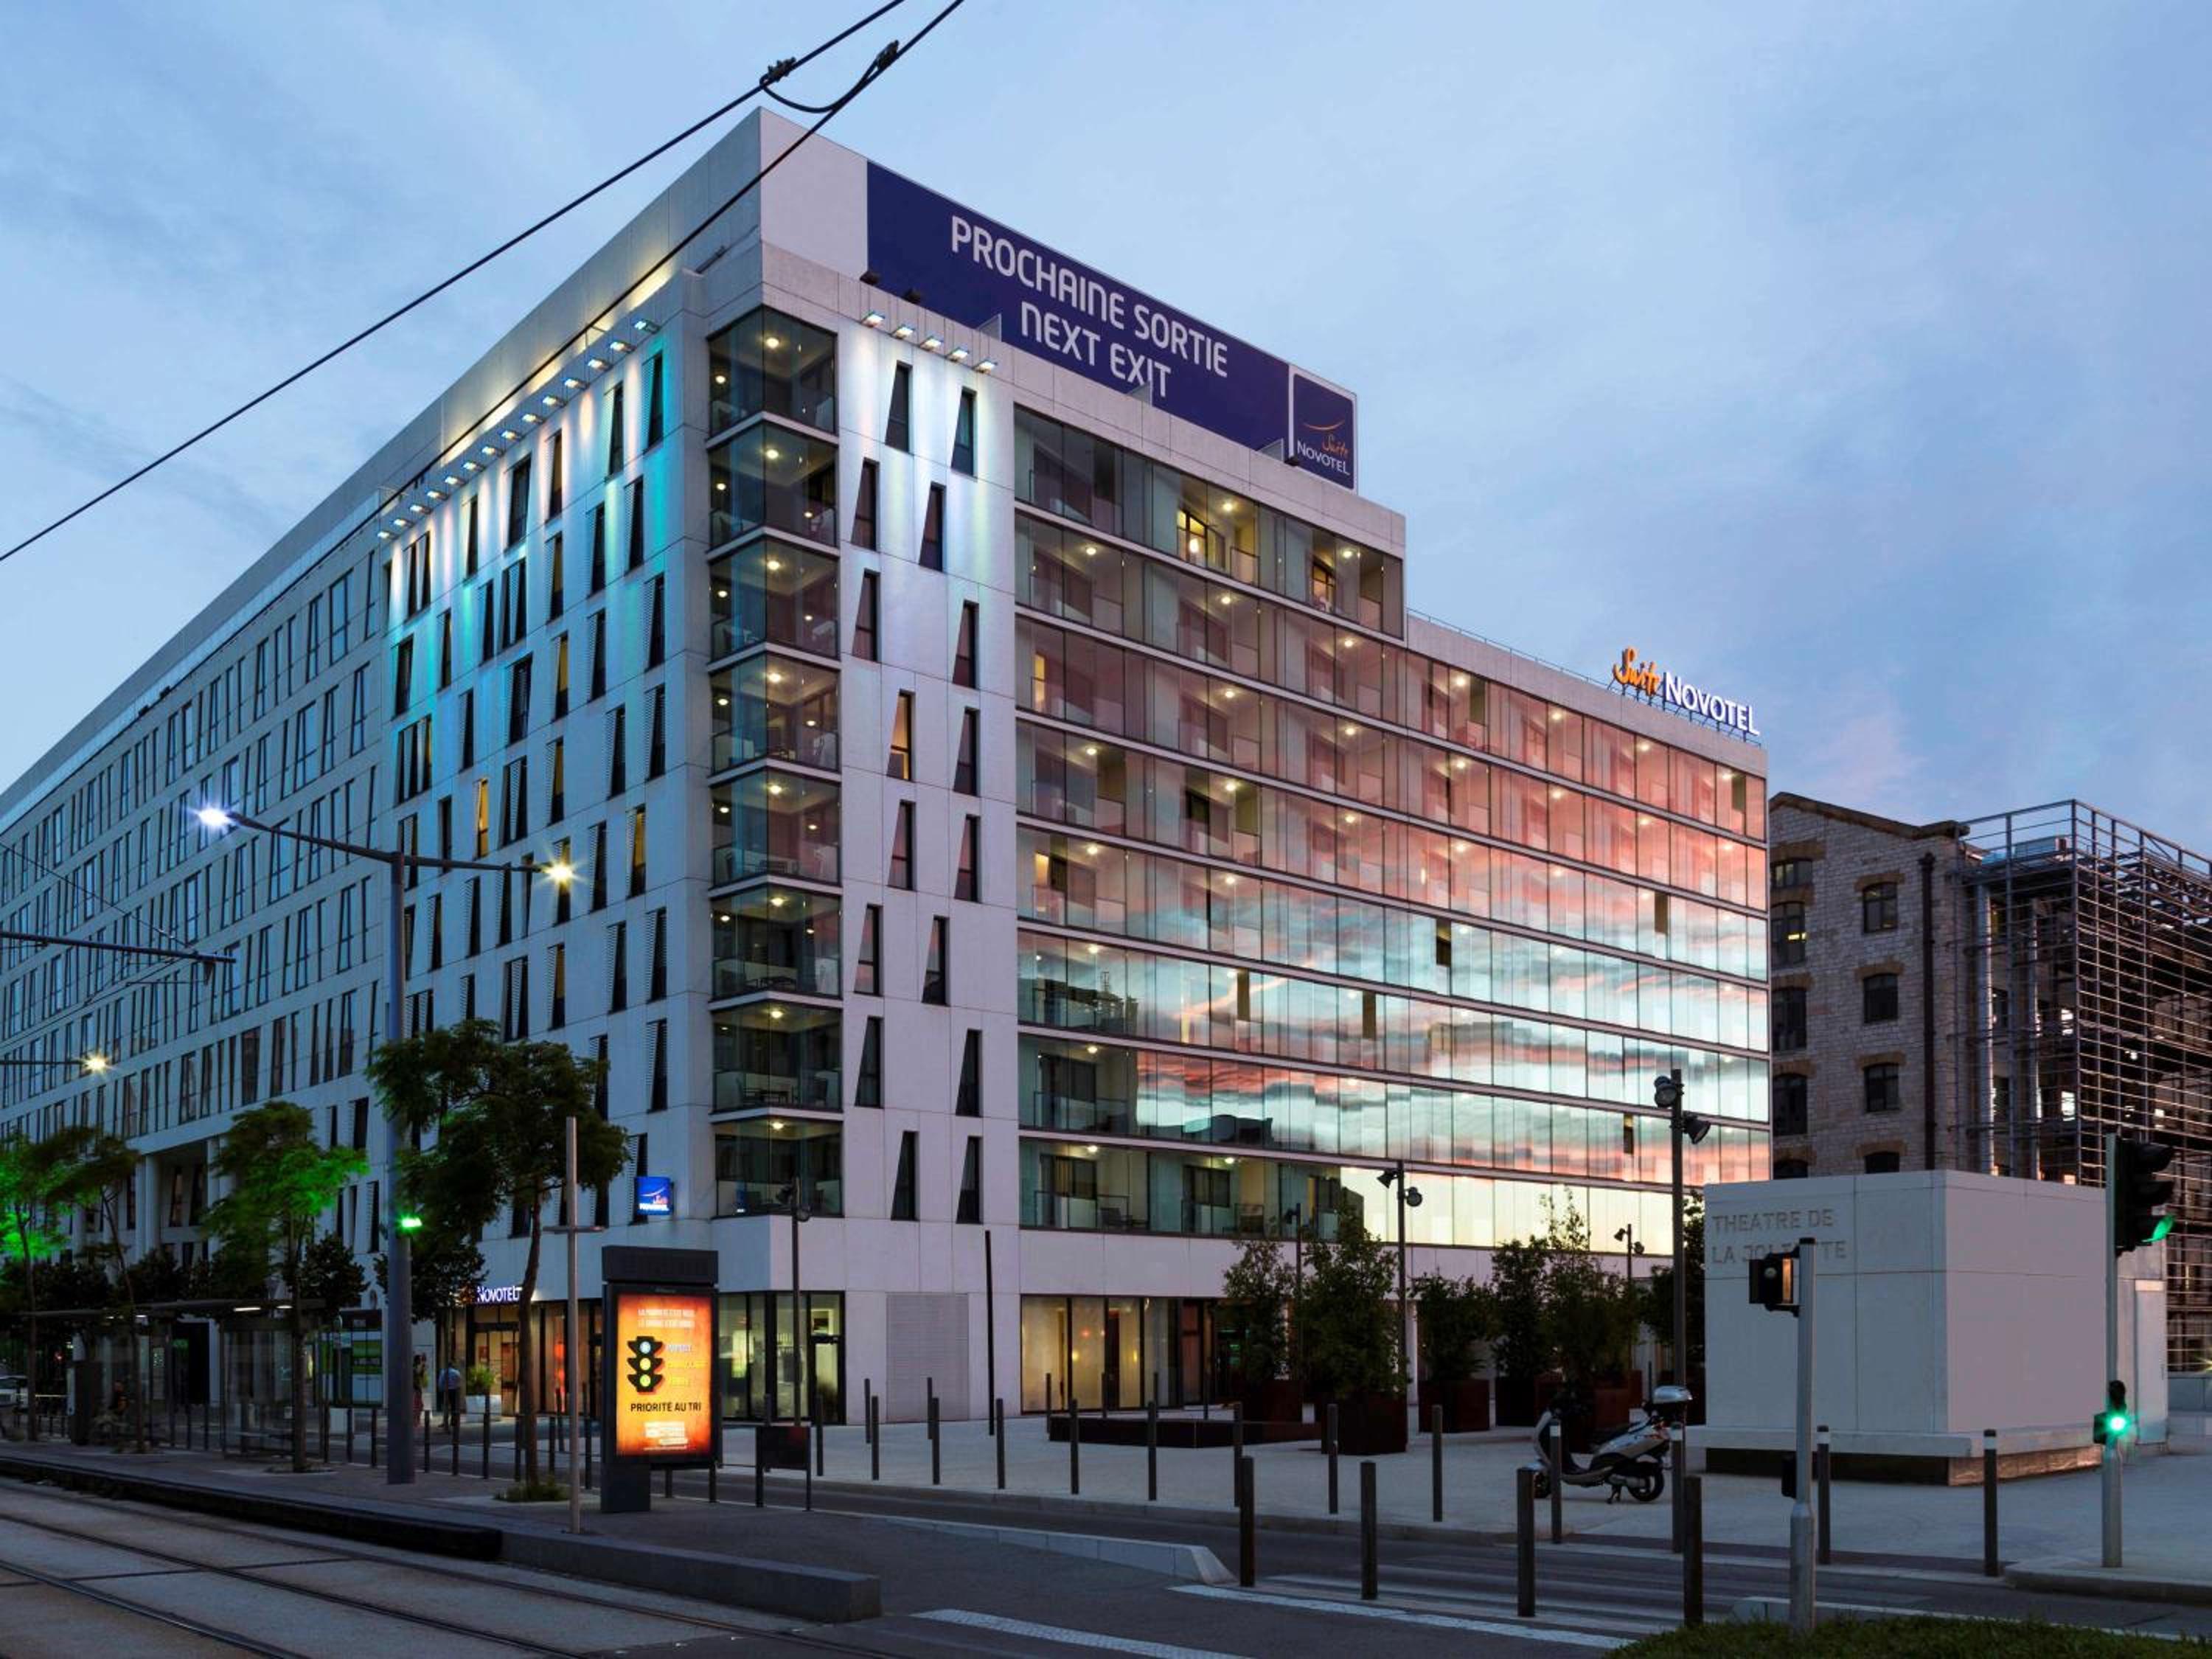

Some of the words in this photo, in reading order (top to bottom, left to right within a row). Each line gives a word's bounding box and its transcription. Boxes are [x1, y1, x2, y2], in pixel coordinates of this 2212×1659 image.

[952, 215, 1125, 330] PROCHAINE
[1134, 305, 1228, 378] SORTIE
[1021, 301, 1101, 366] NEXT
[1110, 343, 1172, 397] EXIT
[1298, 440, 1350, 476] NOVOTEL
[1663, 672, 1760, 736] NOVOTEL
[1712, 1211, 1801, 1235] THEATRE
[1808, 1208, 1834, 1228] DE
[1712, 1246, 1736, 1262] LA
[675, 1402, 686, 1411] AU
[688, 1402, 702, 1411] TRI
